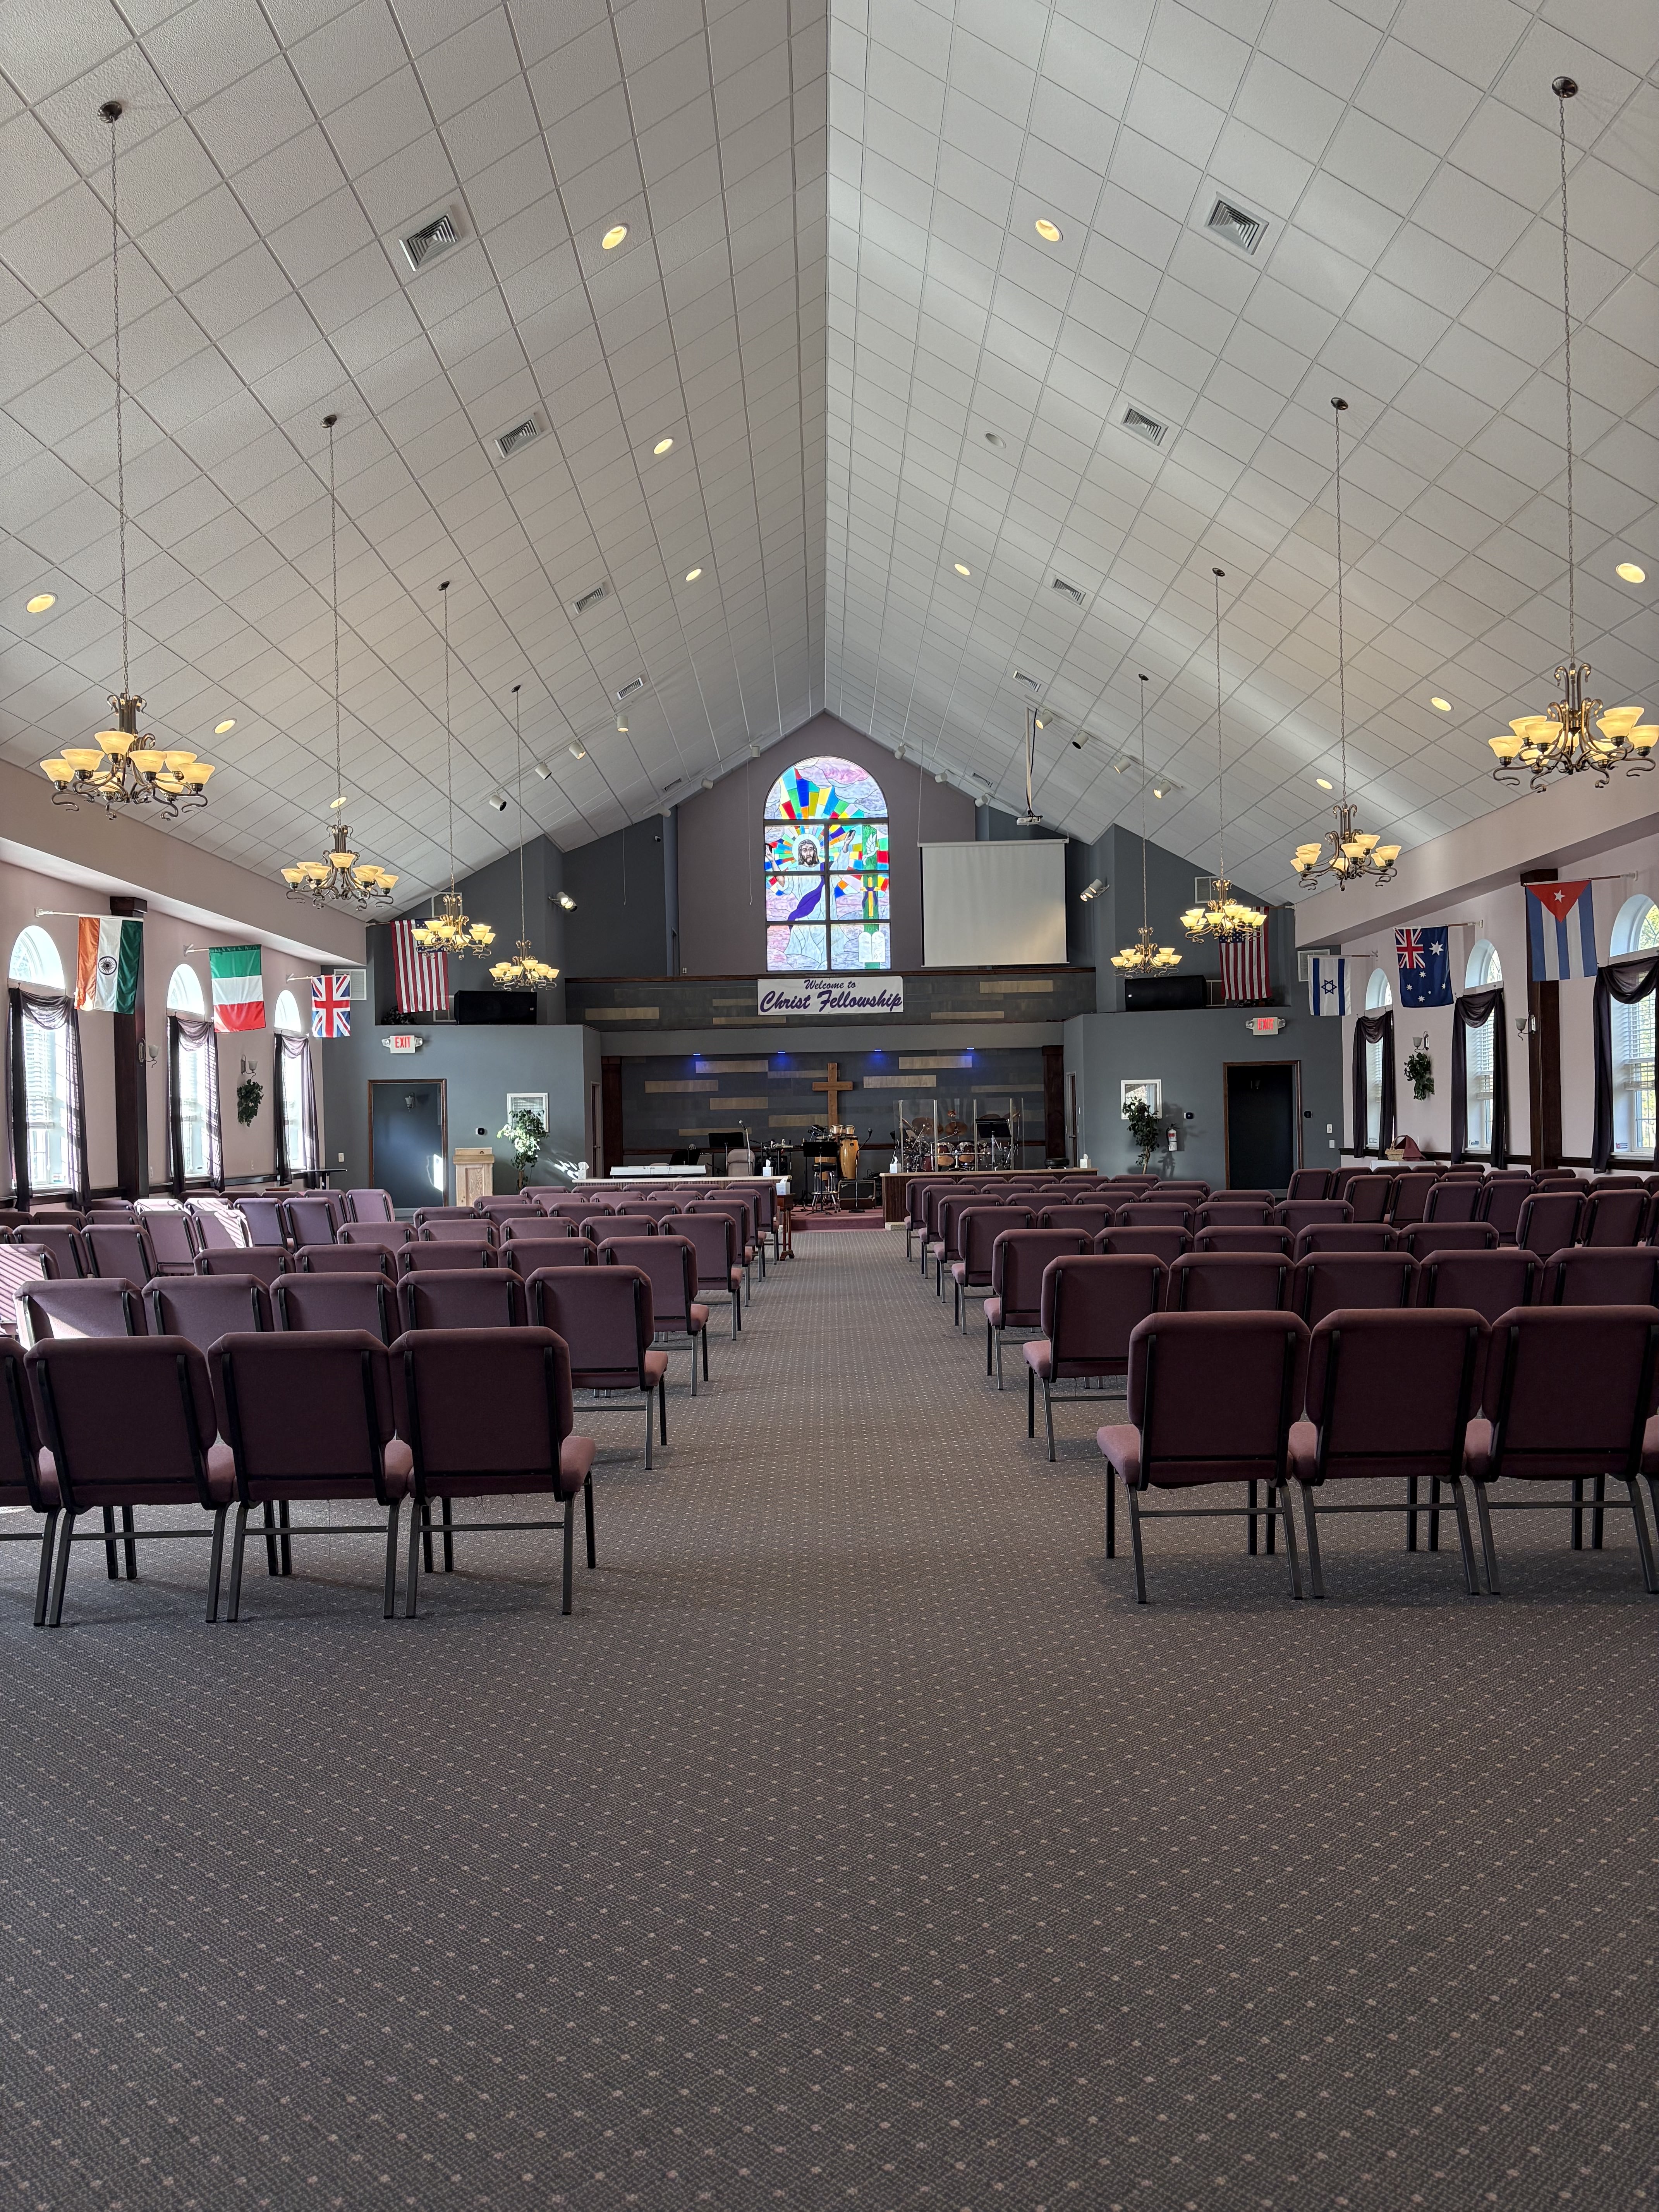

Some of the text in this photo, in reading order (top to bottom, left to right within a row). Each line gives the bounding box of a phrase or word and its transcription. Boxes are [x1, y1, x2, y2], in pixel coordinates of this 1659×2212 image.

[804, 979, 856, 989] Welcome to
[760, 989, 902, 1012] Christ Fellowship
[395, 1037, 410, 1048] EXIT
